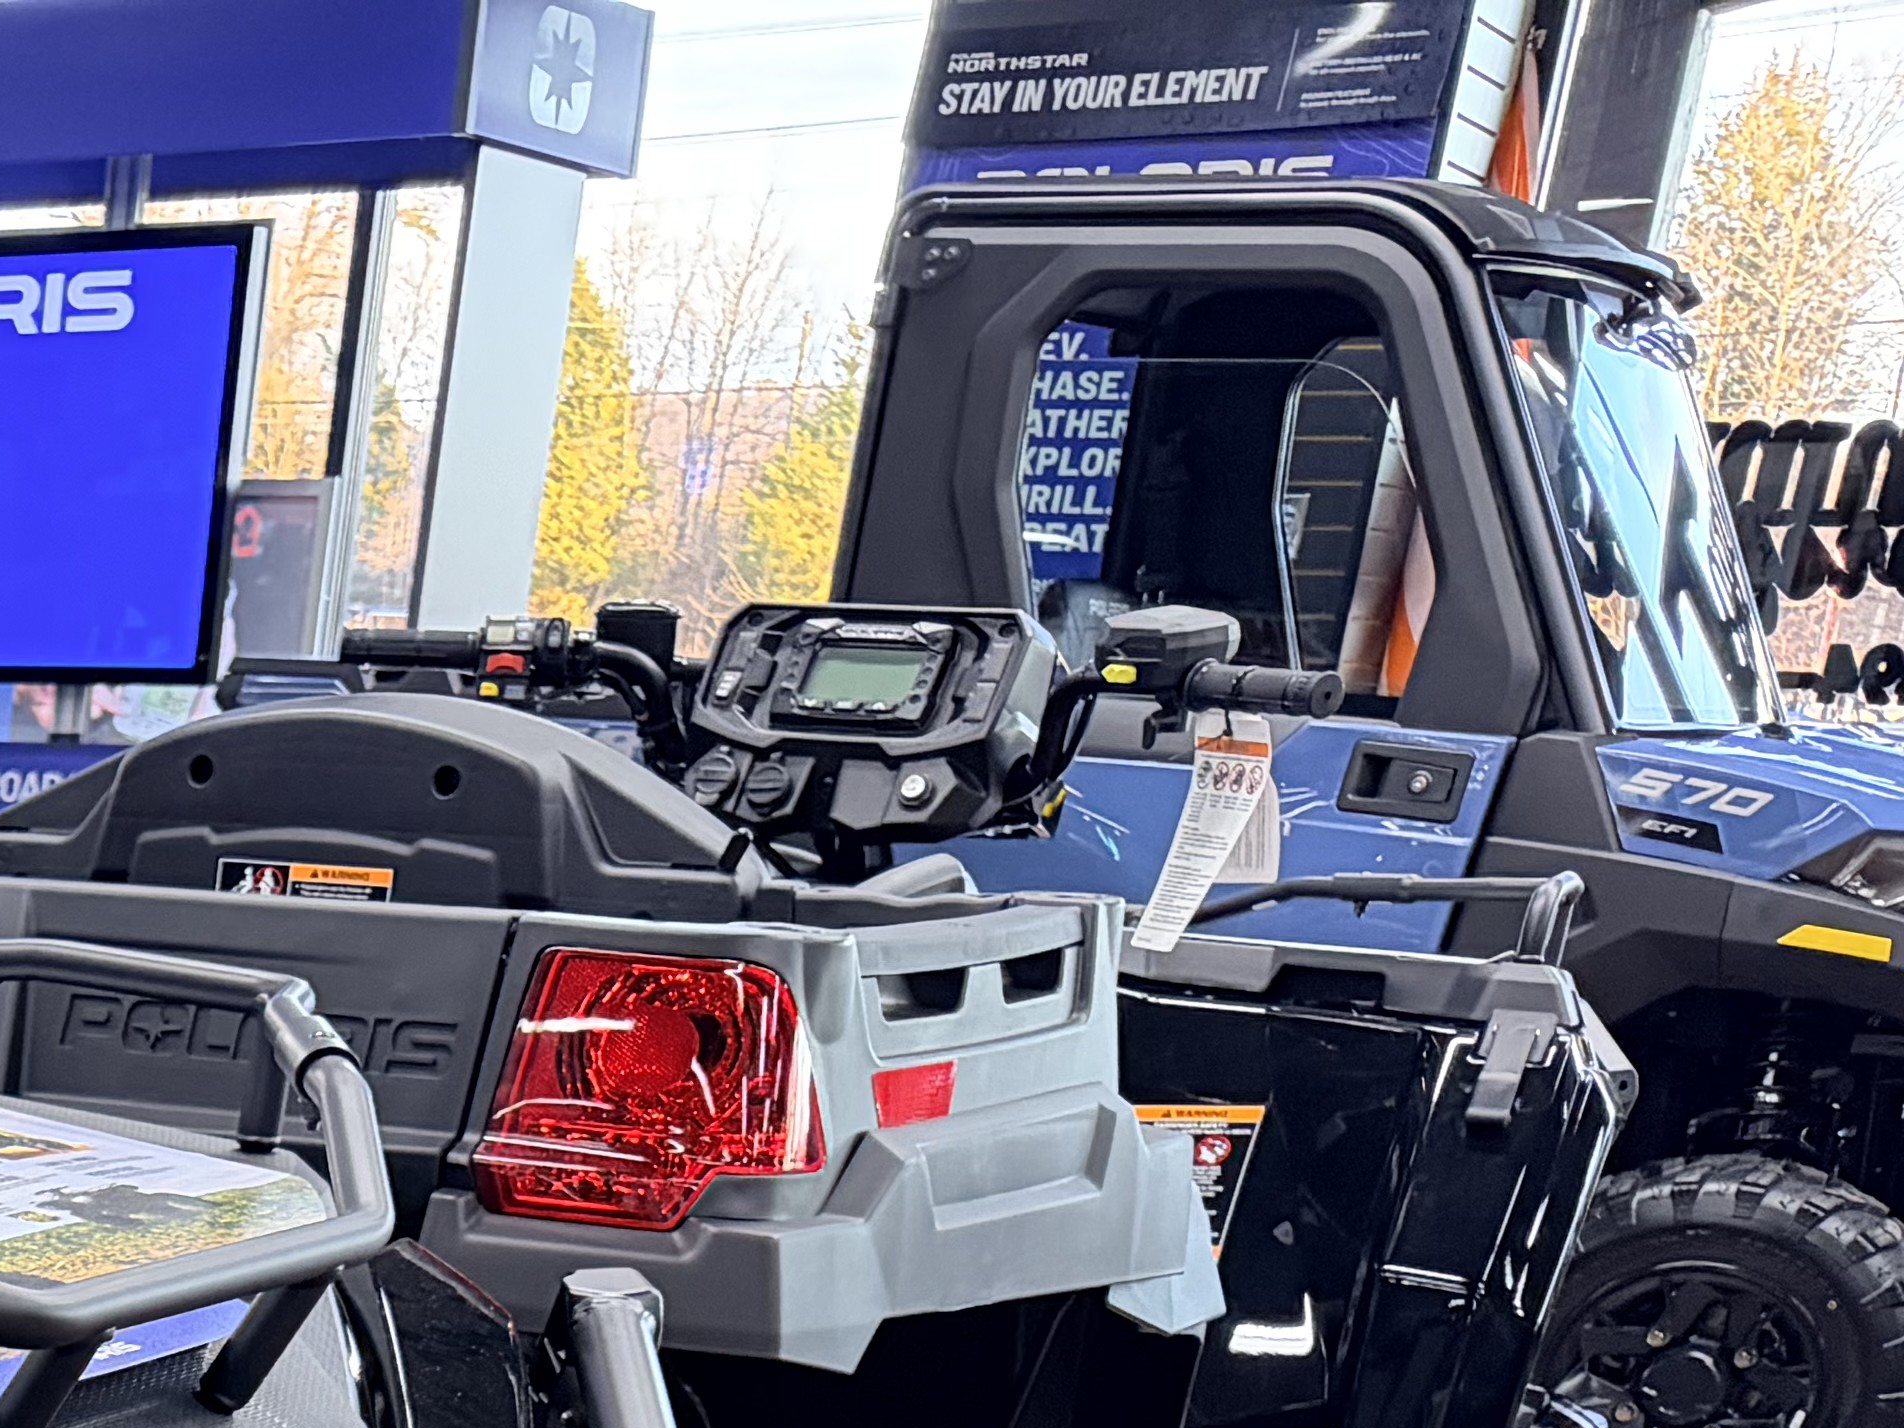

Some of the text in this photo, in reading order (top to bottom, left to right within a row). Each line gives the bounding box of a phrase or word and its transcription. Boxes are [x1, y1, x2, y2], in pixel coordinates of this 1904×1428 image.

[947, 53, 1088, 74] NORTHSTAR
[939, 80, 1012, 116] STAY
[1012, 77, 1045, 113] IN
[1052, 74, 1130, 112] YOUR
[1128, 66, 1269, 107] ELEMENT
[1039, 331, 1089, 362] EV.
[1033, 370, 1131, 402] HASE.
[1026, 408, 1130, 439] ATHER
[1021, 446, 1122, 478] XPLOR
[1021, 485, 1112, 515] RILL.
[1620, 767, 1775, 818] 570
[1641, 818, 1697, 839] EFI
